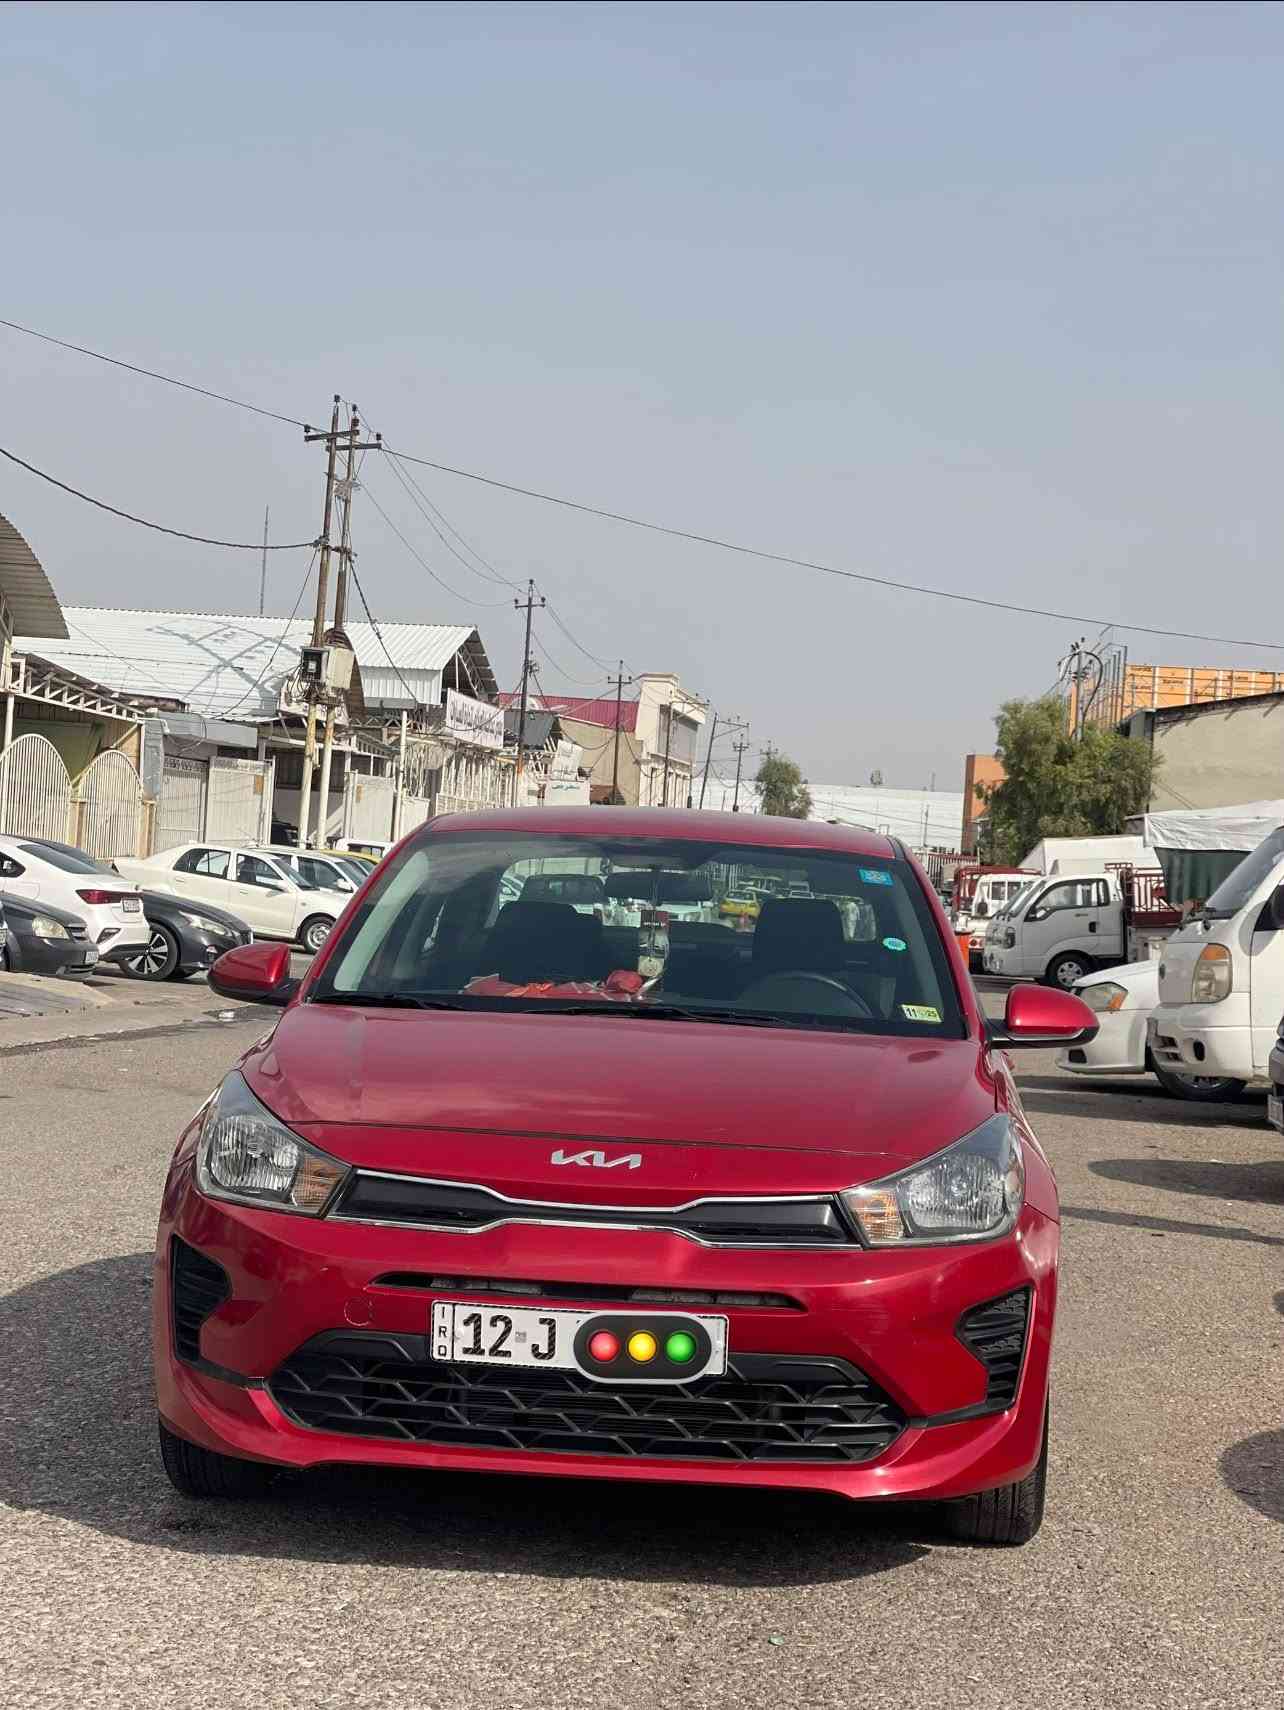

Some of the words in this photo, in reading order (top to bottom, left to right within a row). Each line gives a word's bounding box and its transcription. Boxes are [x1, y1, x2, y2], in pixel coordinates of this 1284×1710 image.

[906, 1008, 917, 1017] 11
[551, 1149, 642, 1169] KIA
[462, 1313, 512, 1357] 12
[531, 1318, 556, 1360] J
